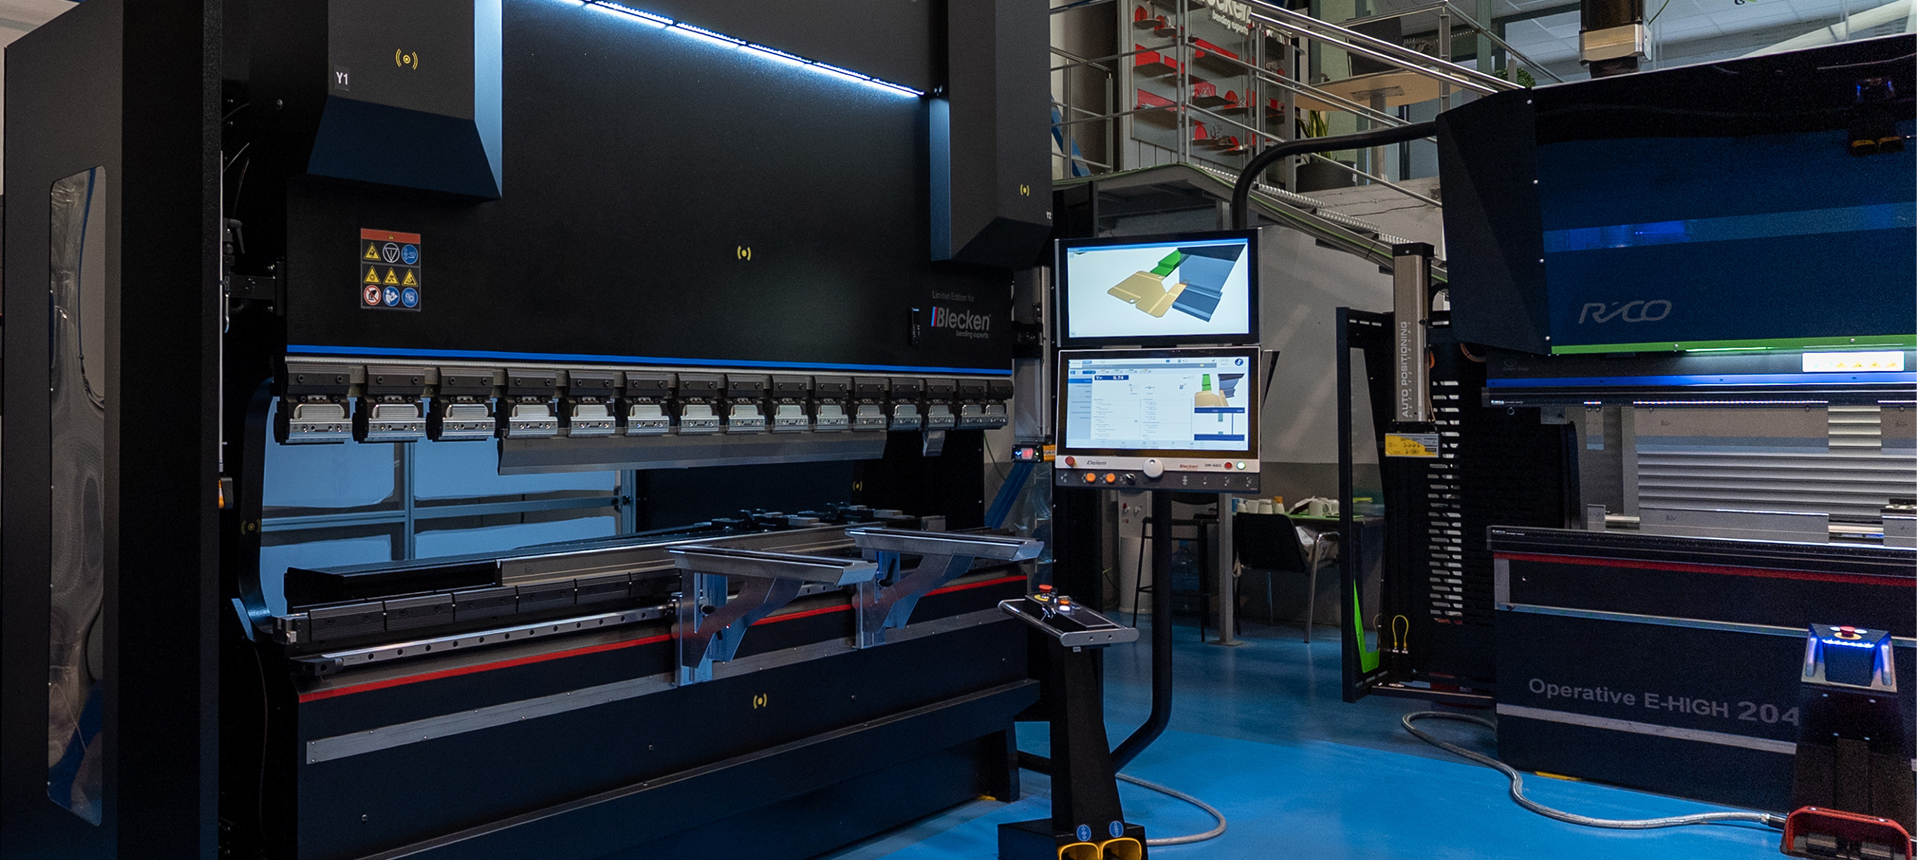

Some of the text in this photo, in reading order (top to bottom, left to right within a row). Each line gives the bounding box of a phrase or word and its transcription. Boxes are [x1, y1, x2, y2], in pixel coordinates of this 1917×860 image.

[335, 71, 348, 85] Y1
[951, 292, 967, 302] Edition
[936, 306, 990, 331] Blecken
[1400, 321, 1408, 386] POSITIONING
[1528, 678, 1636, 706] Operative
[1644, 692, 1729, 718] E-HIGH
